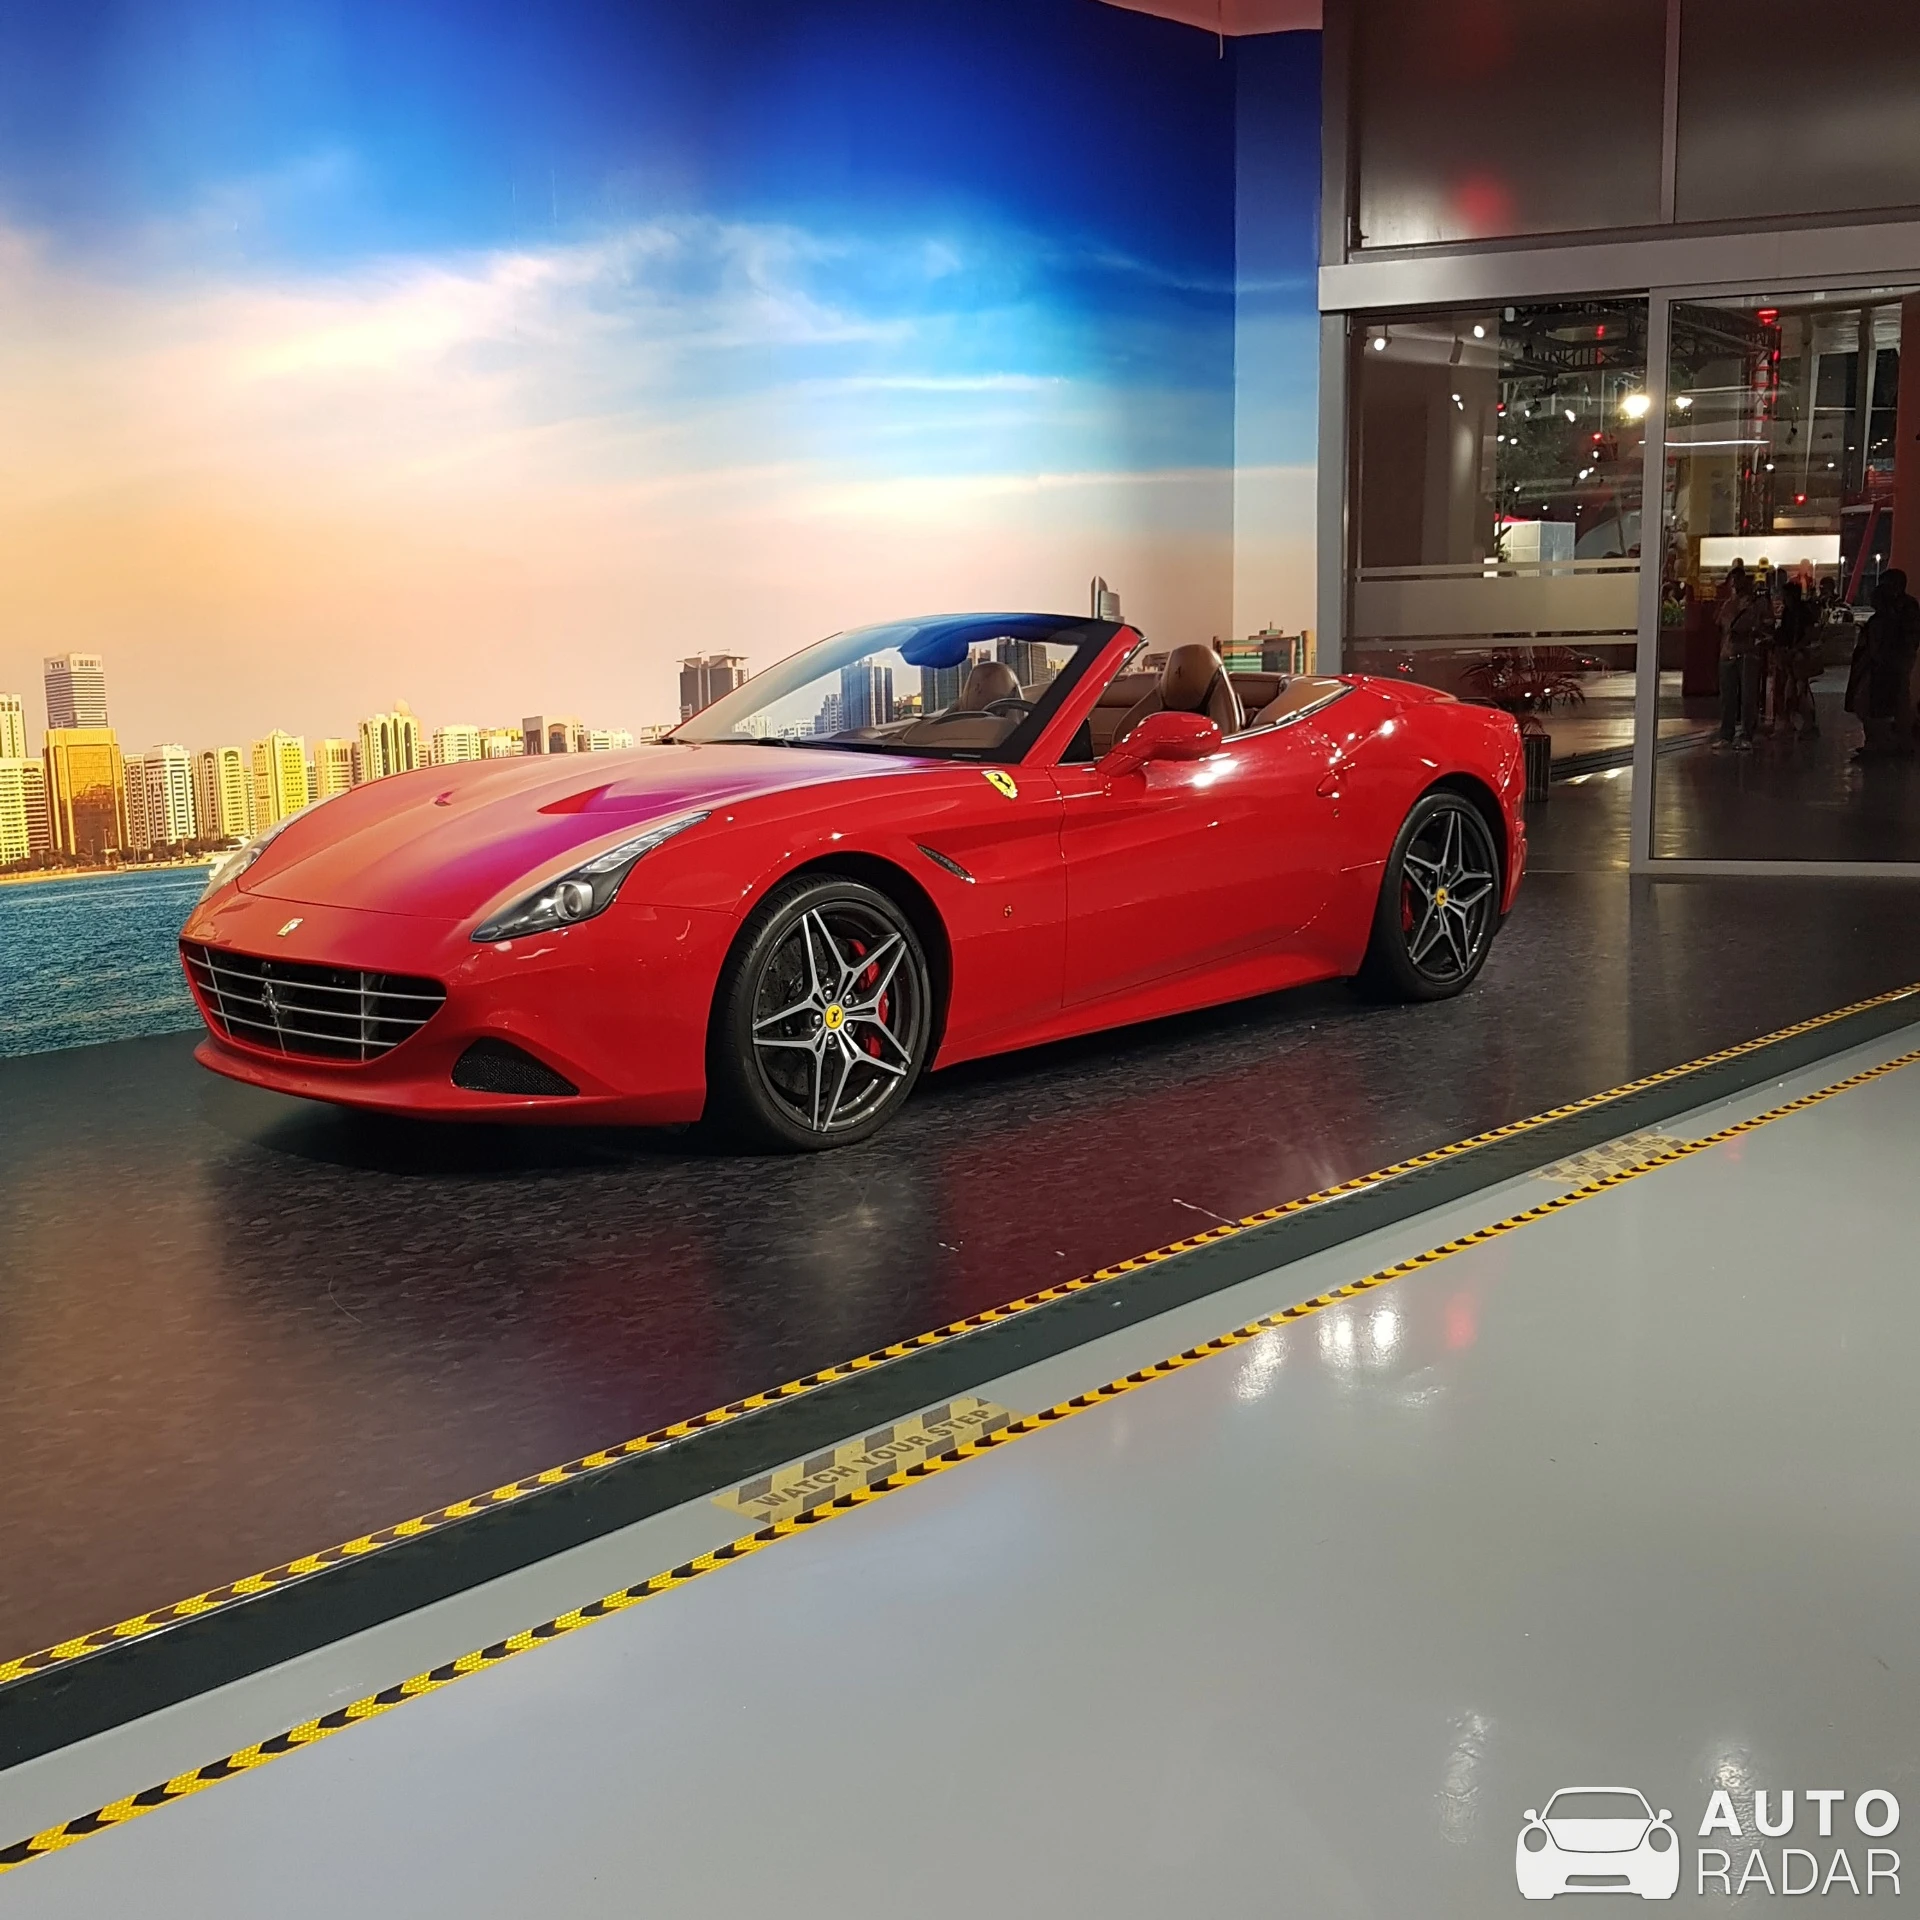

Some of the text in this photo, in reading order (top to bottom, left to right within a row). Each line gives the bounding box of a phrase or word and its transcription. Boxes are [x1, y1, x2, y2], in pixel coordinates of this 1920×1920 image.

[754, 1409, 994, 1507] WATCH YOUR STEP
